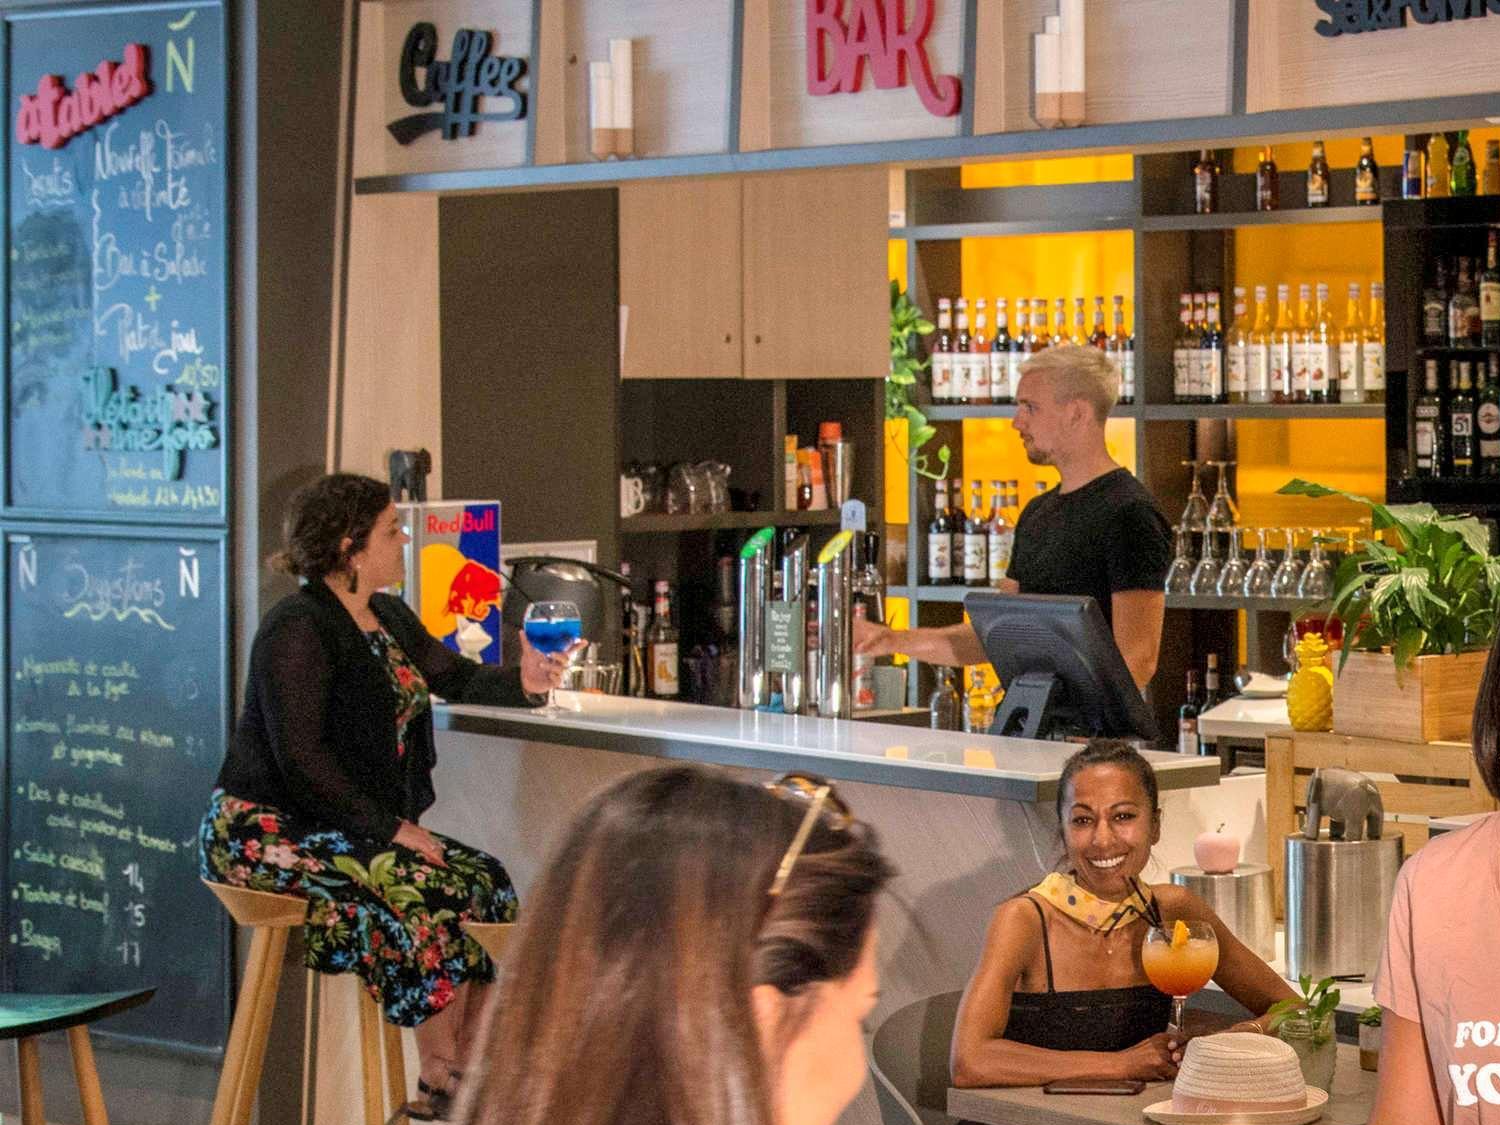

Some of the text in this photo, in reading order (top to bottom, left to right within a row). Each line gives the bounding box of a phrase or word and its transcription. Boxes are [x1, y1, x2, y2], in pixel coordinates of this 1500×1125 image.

[386, 21, 527, 145] Coffee
[806, 0, 962, 117] BAR
[426, 509, 495, 534] Red Bull
